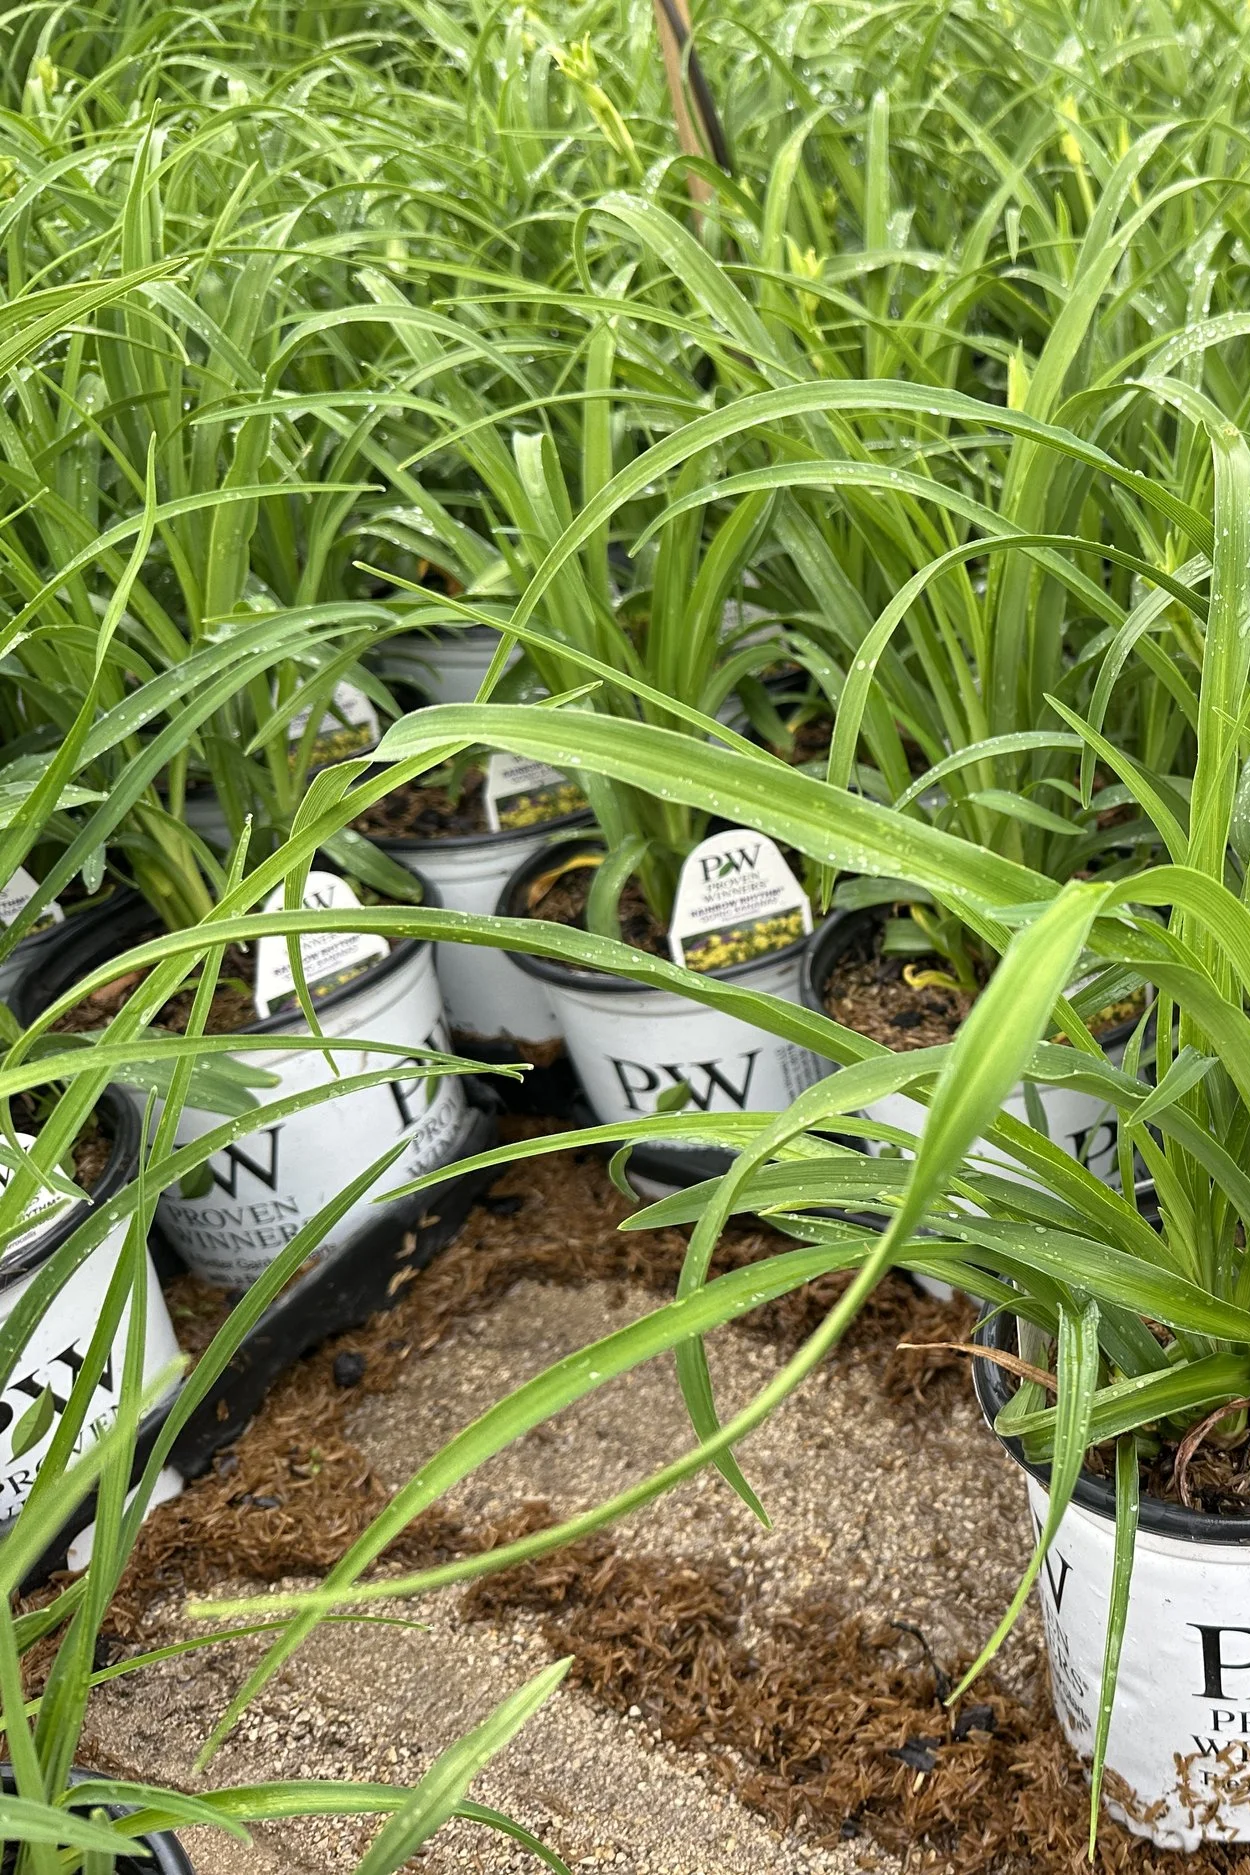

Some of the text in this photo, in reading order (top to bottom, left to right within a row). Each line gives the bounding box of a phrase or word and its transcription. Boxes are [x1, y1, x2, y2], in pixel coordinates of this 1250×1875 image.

[700, 844, 762, 882] PW
[603, 1048, 764, 1114] PW
[167, 1194, 299, 1231] PROVEN
[170, 1215, 312, 1253] WINNER
